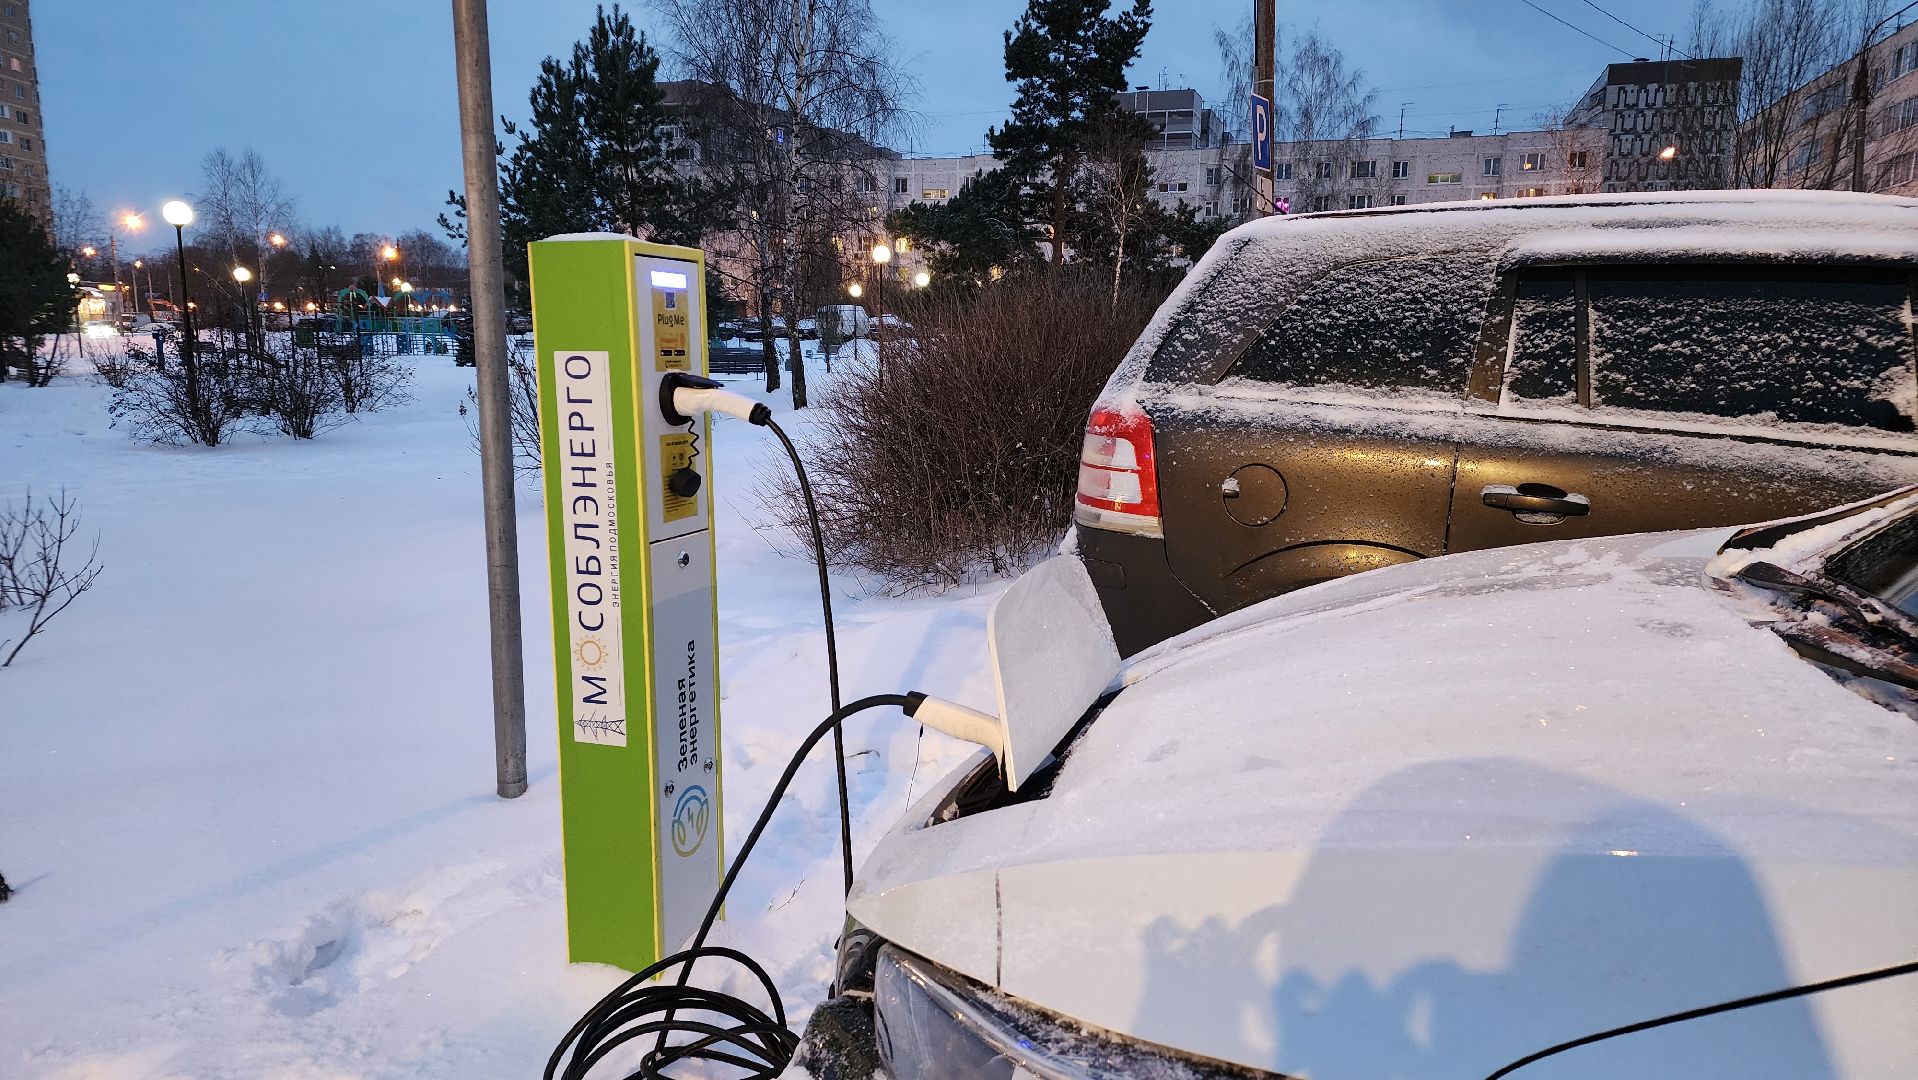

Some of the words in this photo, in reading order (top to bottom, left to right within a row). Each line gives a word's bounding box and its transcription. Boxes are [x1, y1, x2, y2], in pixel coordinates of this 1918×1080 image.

[1256, 104, 1267, 160] P
[565, 355, 608, 705] МОСОБЛЭНЕРГО
[606, 462, 619, 551] ПОДМОСКОВЬЯ
[610, 555, 620, 607] ЭНЕРГИЯ
[678, 678, 688, 773] Зеленая
[687, 639, 699, 765] энергетика
